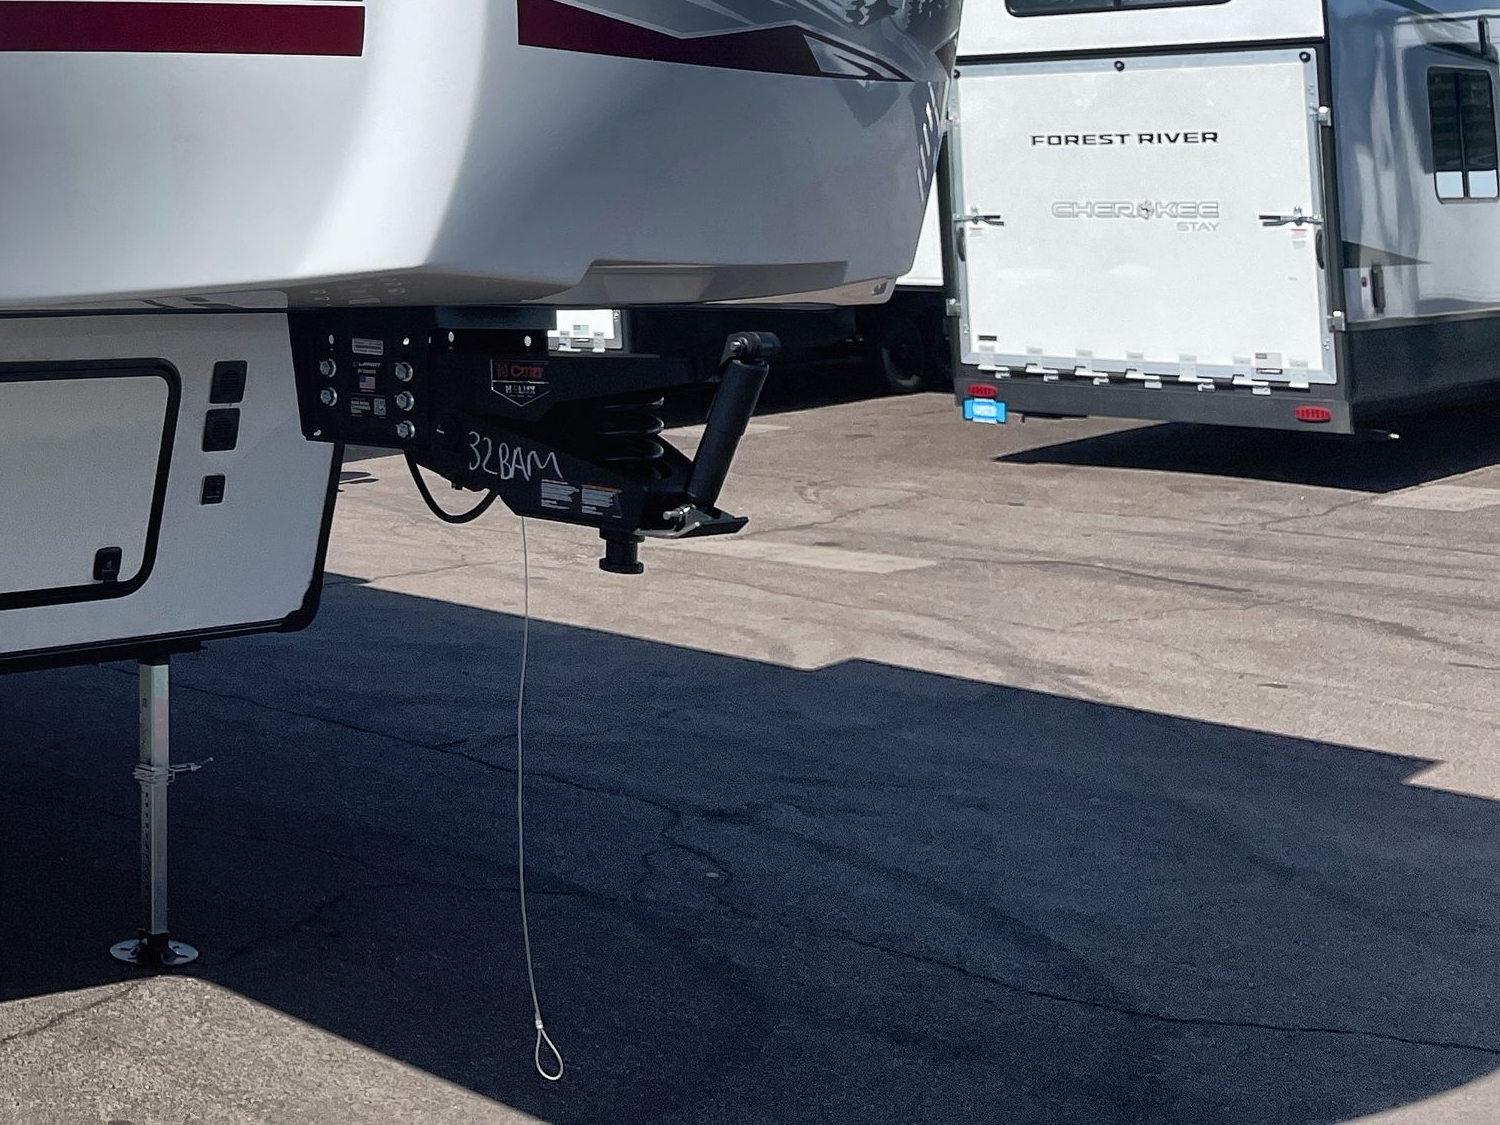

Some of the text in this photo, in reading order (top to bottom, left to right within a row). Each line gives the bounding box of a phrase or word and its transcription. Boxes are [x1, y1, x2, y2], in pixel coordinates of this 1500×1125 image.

[1031, 132, 1219, 146] FOREST RIVER
[1051, 200, 1220, 220] CHEROKEE
[1177, 221, 1220, 232] STAY
[468, 431, 564, 481] 32BAM
